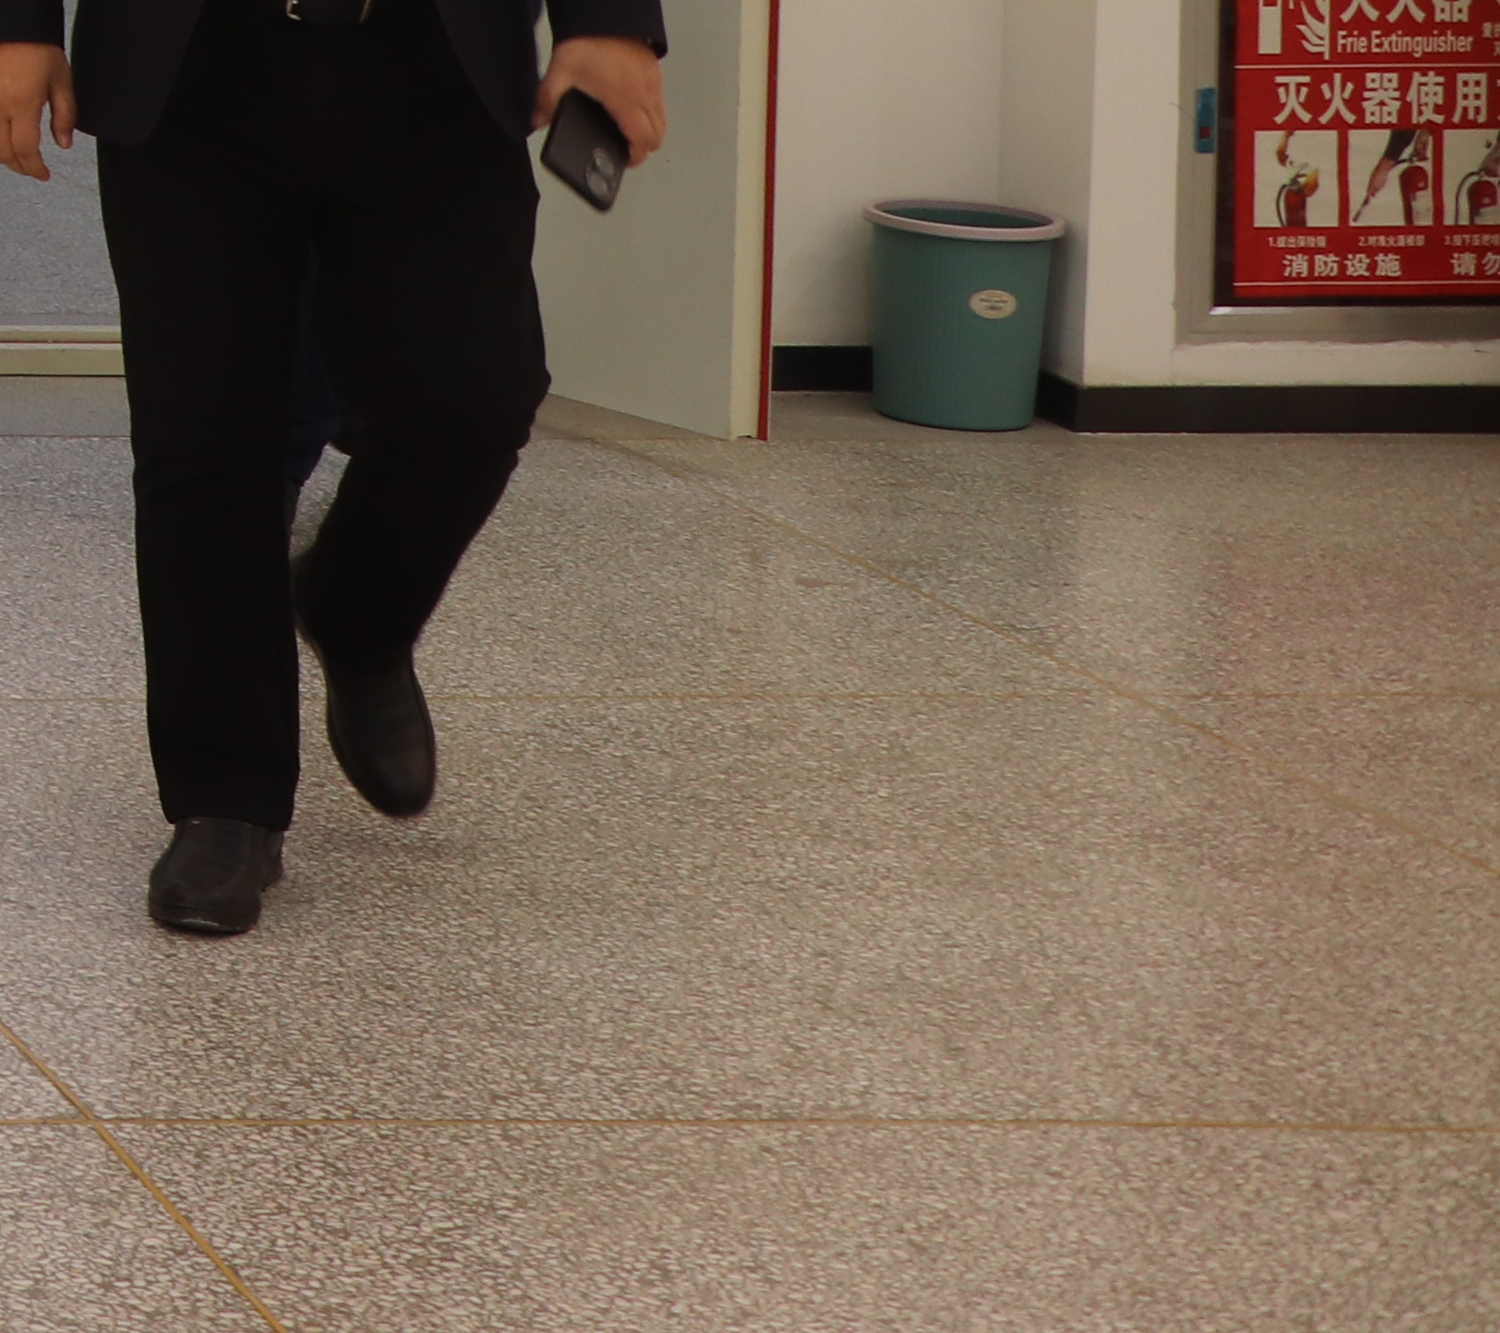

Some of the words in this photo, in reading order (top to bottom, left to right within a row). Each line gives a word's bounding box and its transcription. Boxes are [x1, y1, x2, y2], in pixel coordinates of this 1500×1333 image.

[1337, 30, 1368, 53] Frie
[1370, 30, 1473, 57] Extinguisher
[1273, 70, 1500, 124] 灭火器使用
[1282, 253, 1403, 277] 消防设施
